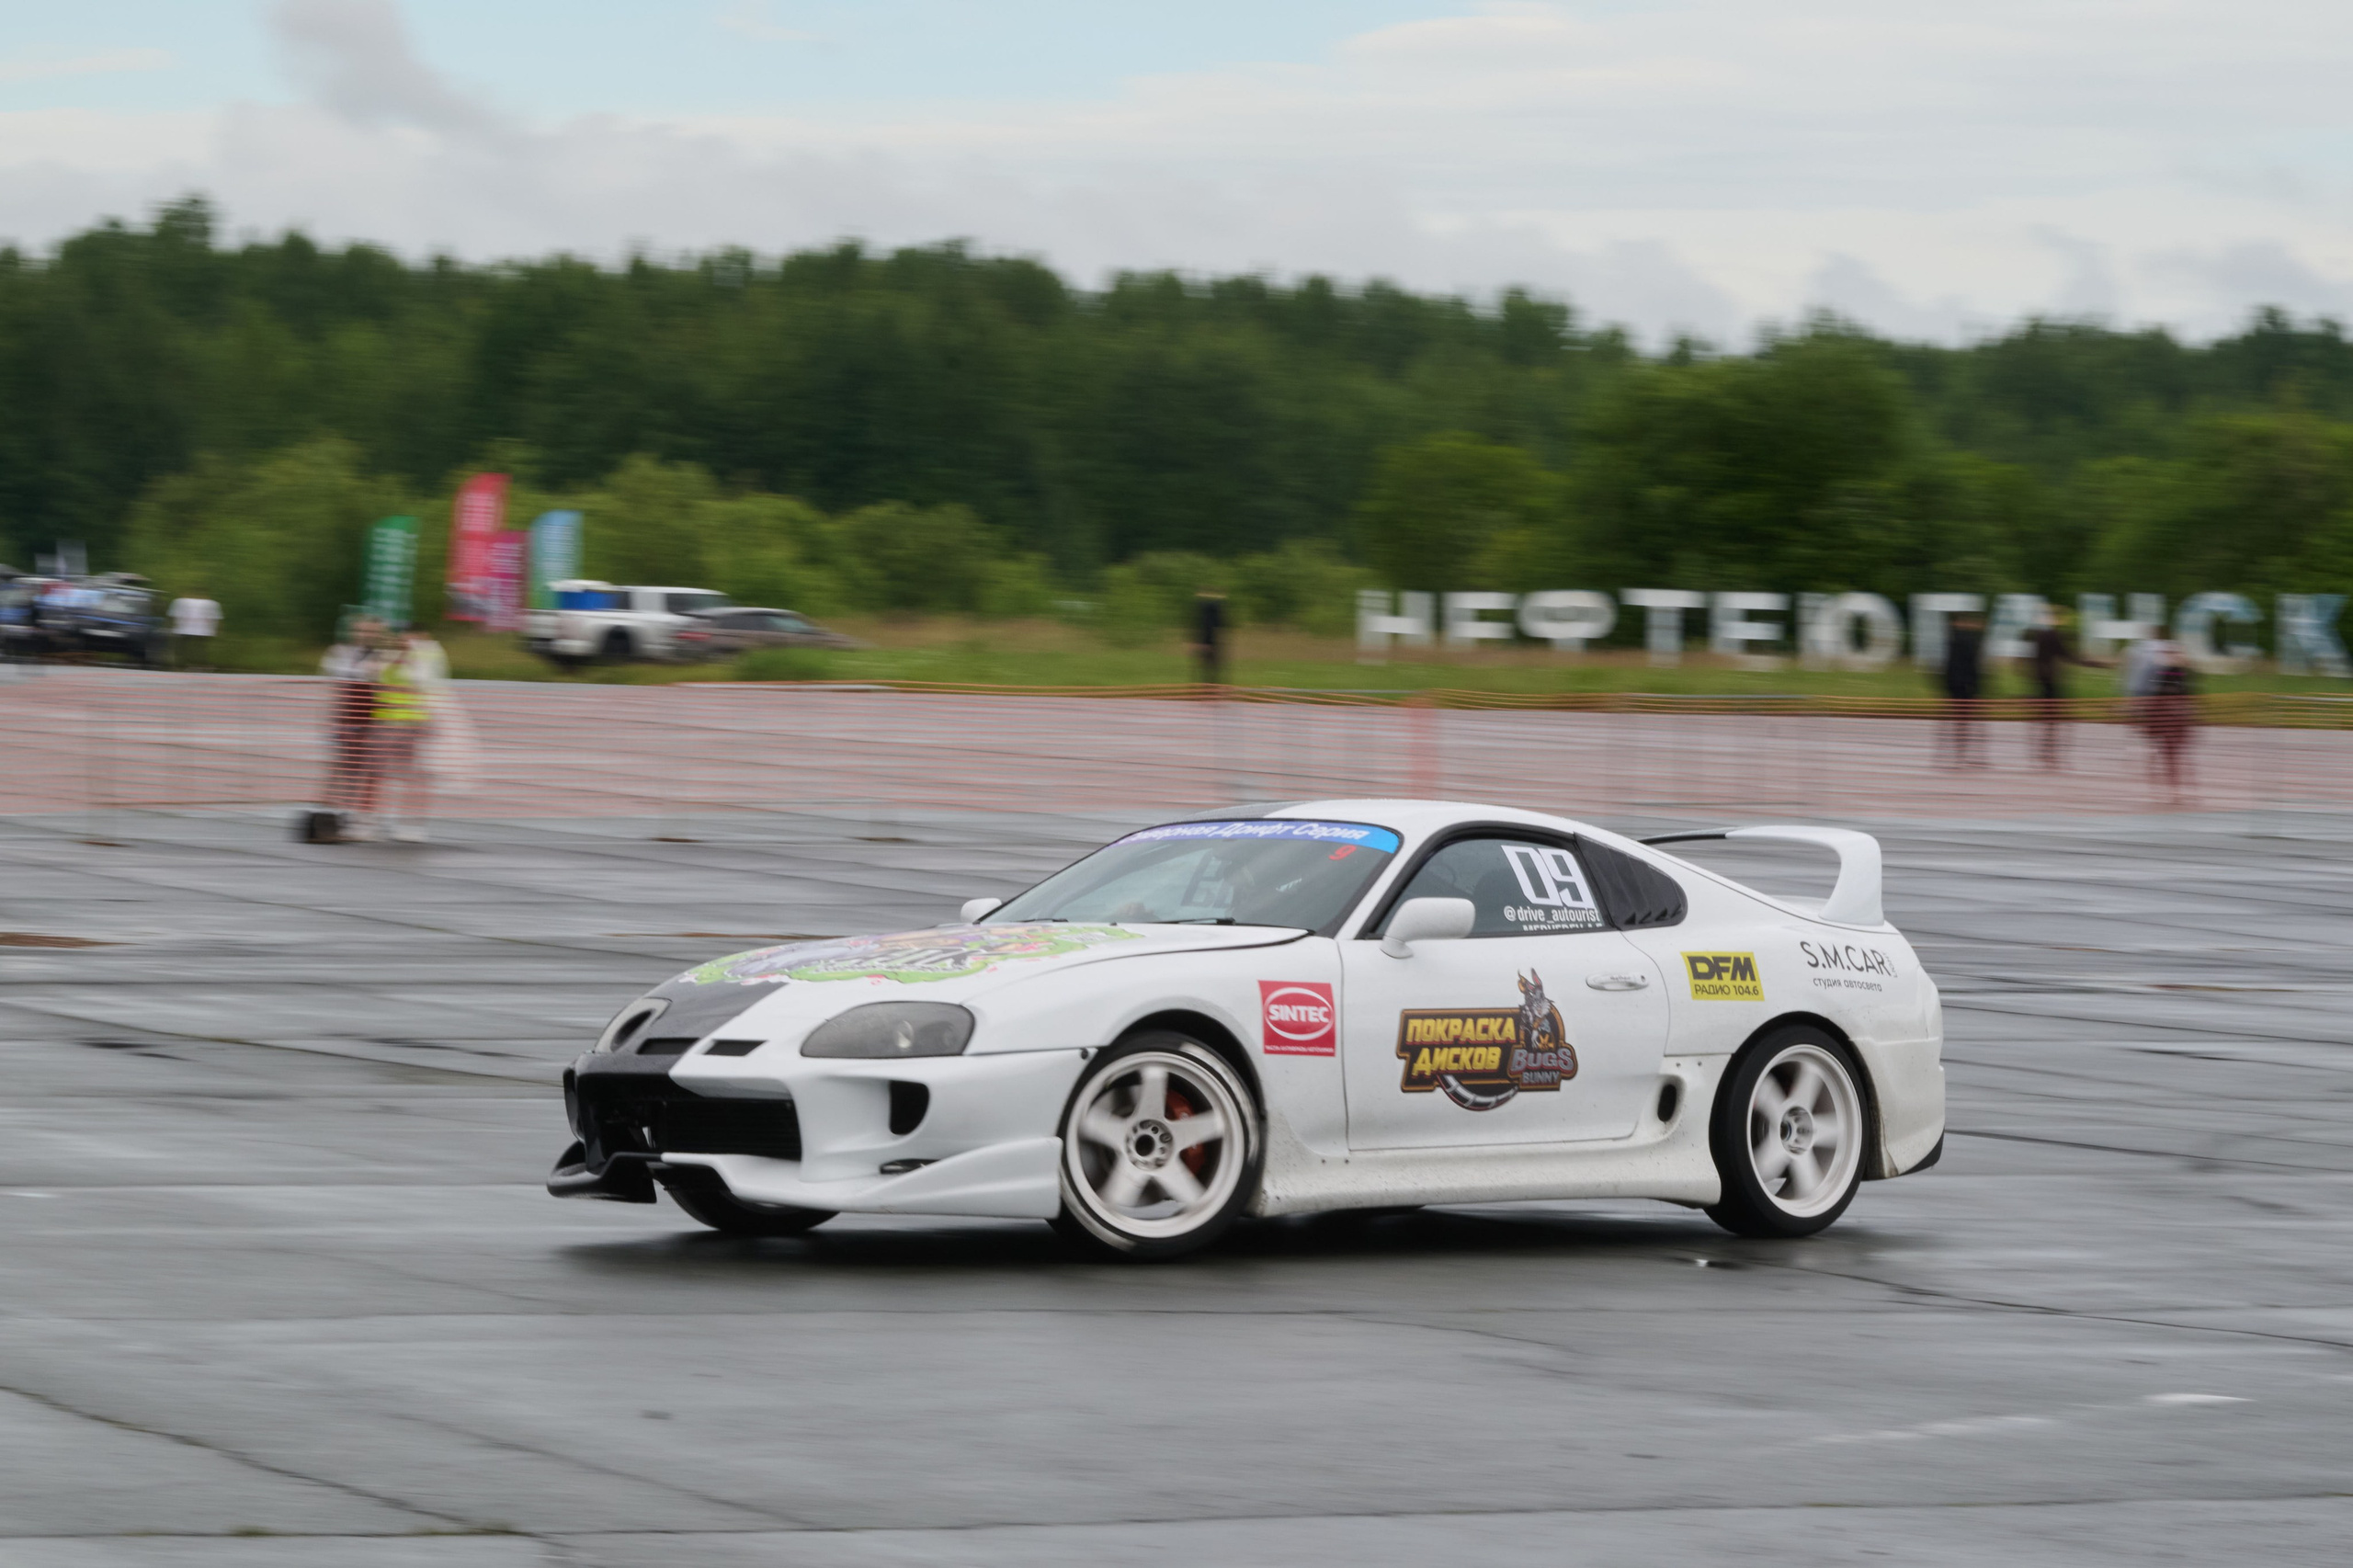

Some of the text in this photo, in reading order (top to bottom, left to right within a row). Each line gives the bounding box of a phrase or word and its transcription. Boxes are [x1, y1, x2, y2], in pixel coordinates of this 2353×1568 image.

[1329, 845, 1357, 861] 9
[1501, 845, 1597, 909] 09
[1503, 905, 1600, 924] @drive_autourist
[1687, 956, 1756, 982] DFM
[1695, 984, 1759, 996] РАДИО 104.6
[1813, 977, 1882, 992] студия автосвета
[1268, 1004, 1330, 1023] SINTEC
[1406, 1017, 1518, 1044] ПОКРАСКА
[1412, 1047, 1502, 1076] ДИСКОВ
[1522, 1071, 1561, 1084] BUNNY
